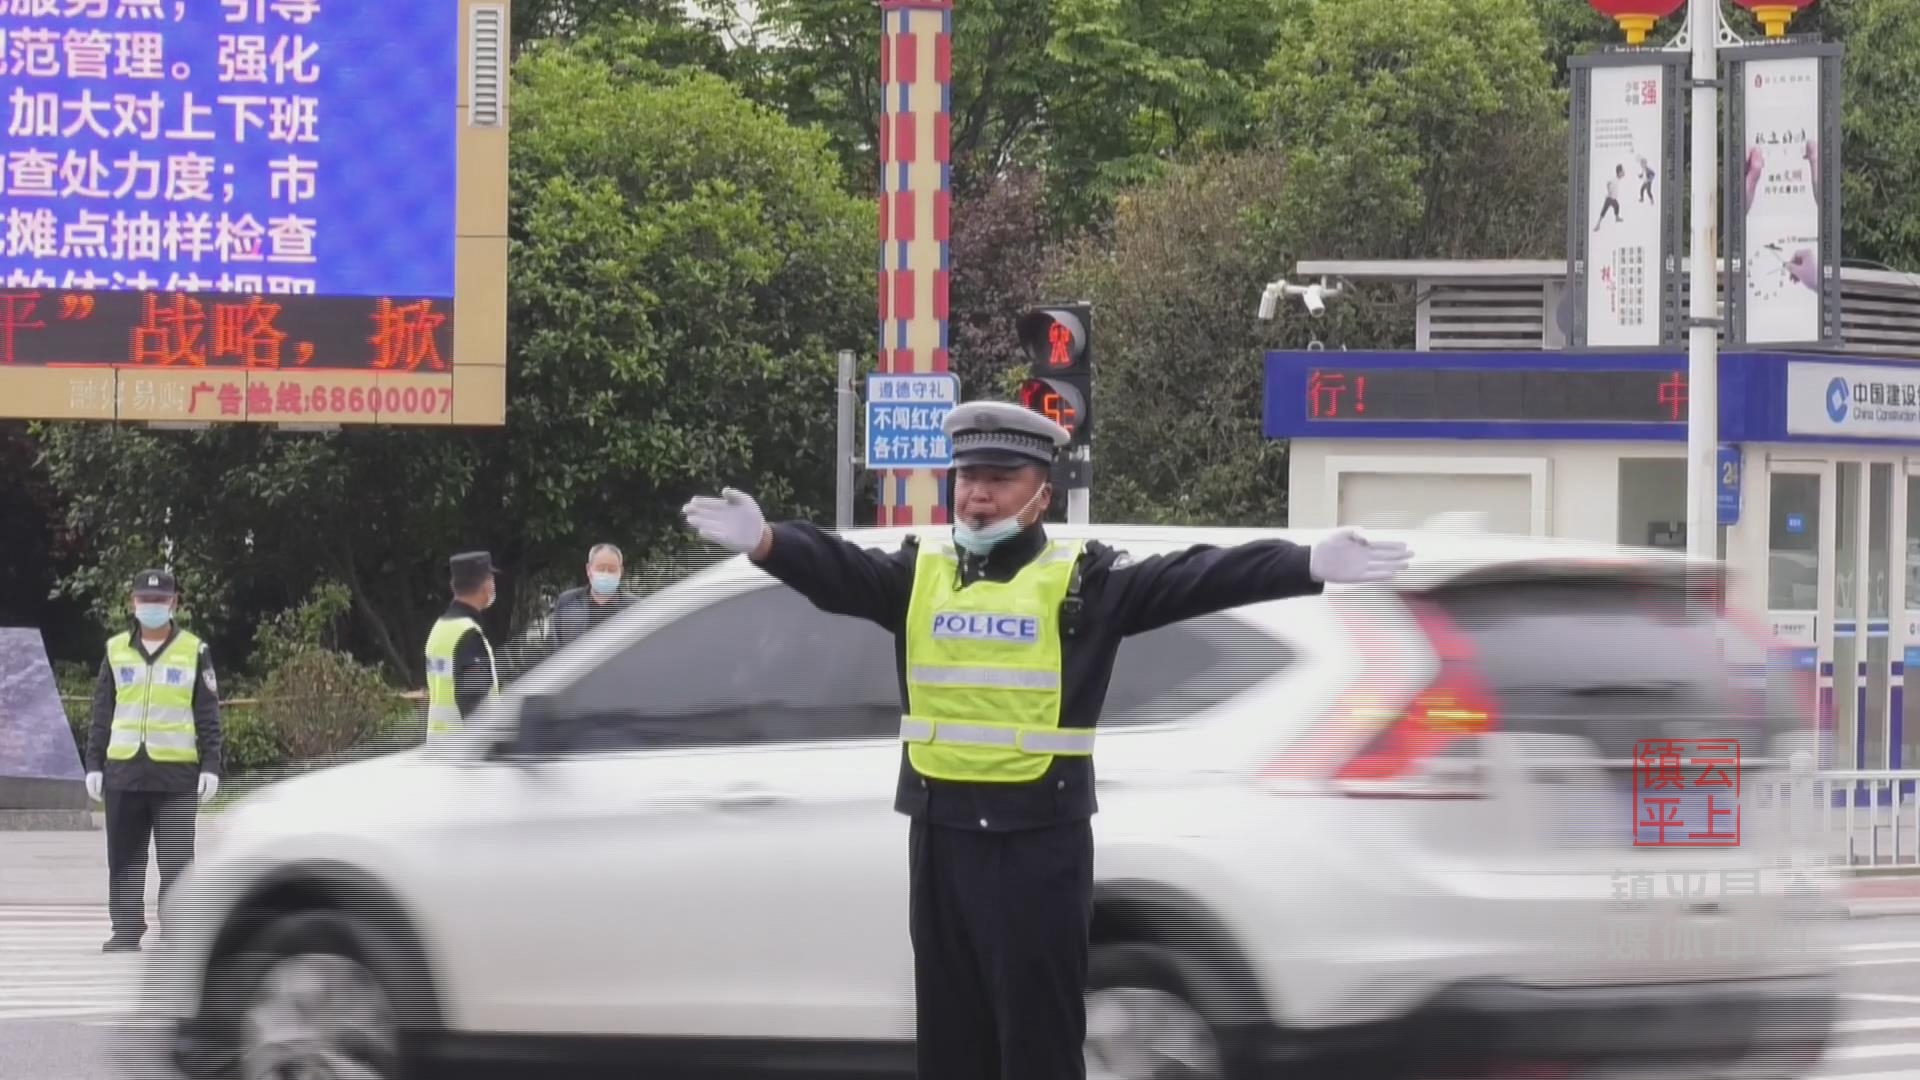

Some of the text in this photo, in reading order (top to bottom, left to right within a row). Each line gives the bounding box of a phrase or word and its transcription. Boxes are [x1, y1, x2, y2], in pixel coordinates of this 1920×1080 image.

[0, 26, 320, 84] 范管理。强化
[8, 86, 320, 143] 加大对上下班
[0, 148, 319, 204] 查处力度；市
[0, 207, 317, 262] 摊点抽样检查
[1853, 382, 1920, 406] 中国建设
[873, 435, 949, 459] 各行其道
[932, 615, 1036, 638] POLICE
